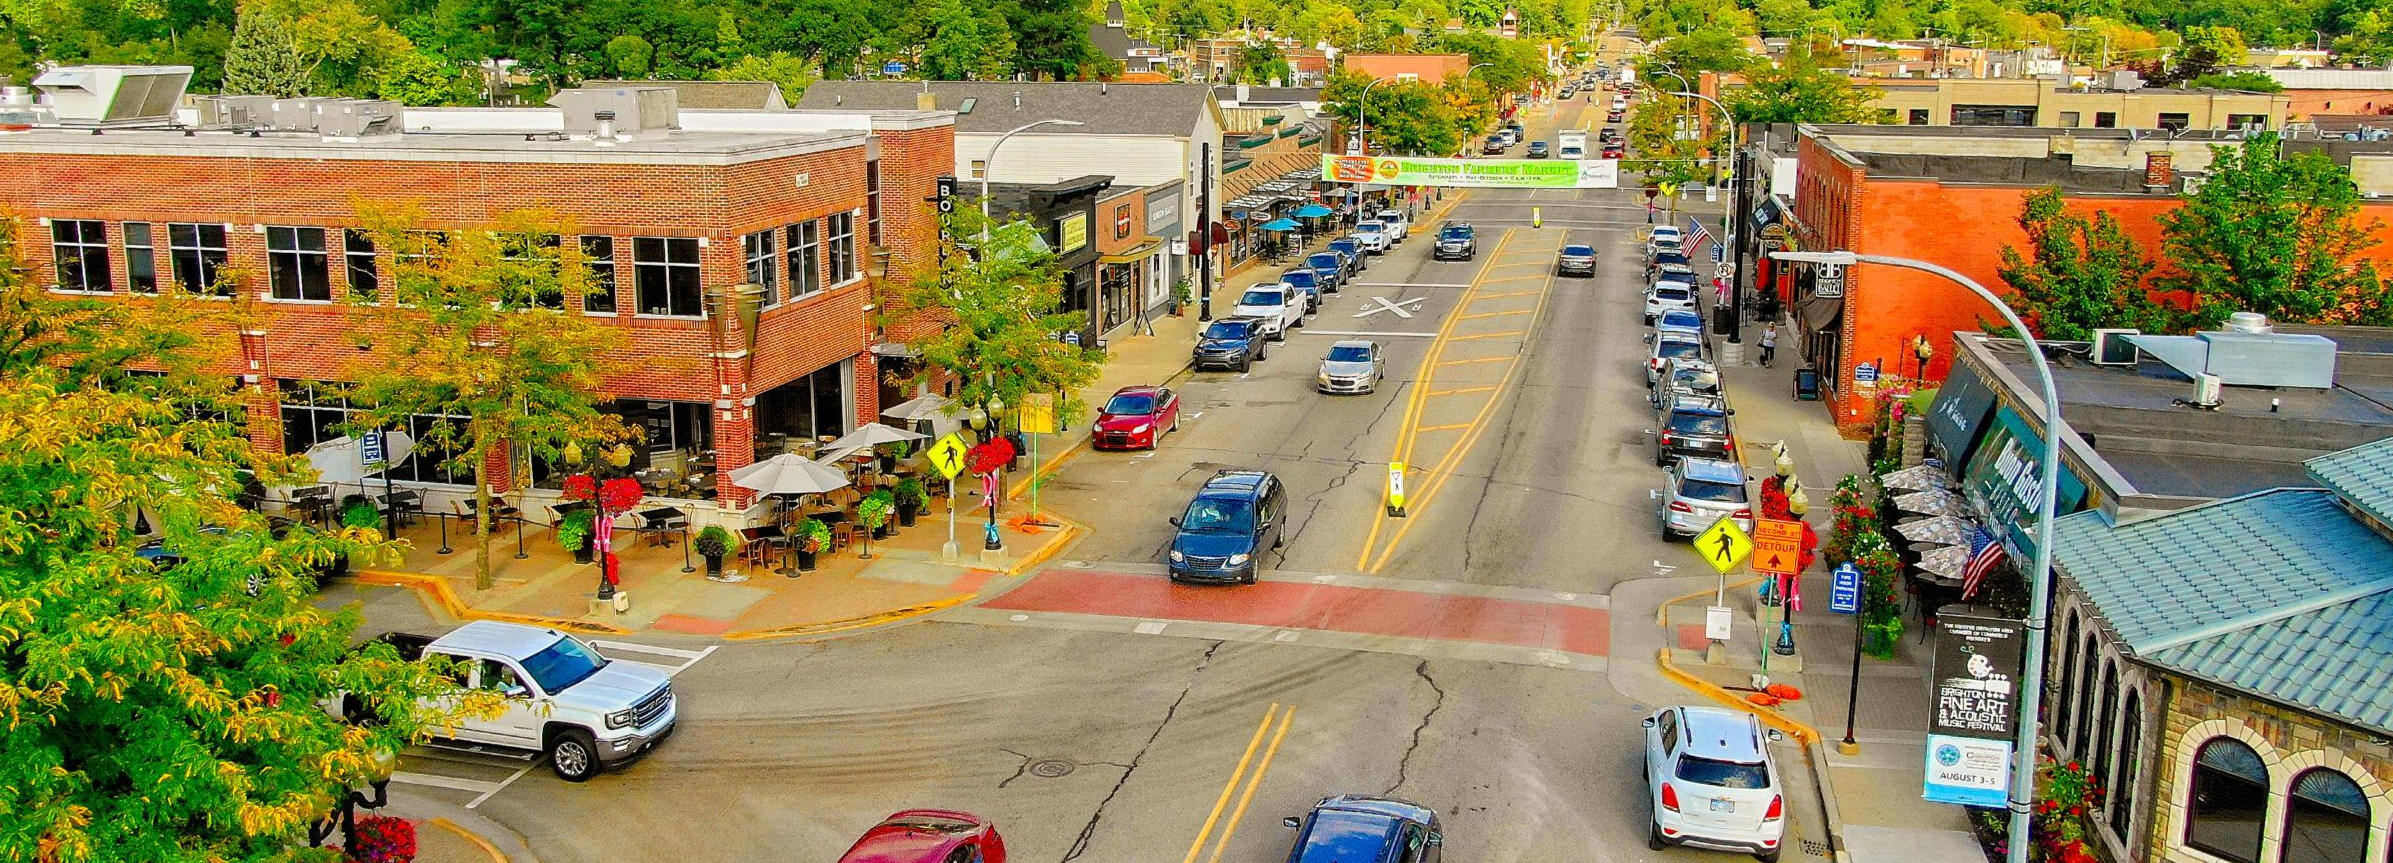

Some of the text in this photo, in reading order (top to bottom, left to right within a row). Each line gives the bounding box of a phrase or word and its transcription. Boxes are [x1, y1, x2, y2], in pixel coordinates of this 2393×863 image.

[1463, 163, 1519, 175] FARMERS
[1522, 164, 1572, 175] MARKET
[1994, 436, 2023, 486] Buon
[1757, 527, 1787, 536] SECOND
[1756, 541, 1796, 553] DETOUR
[1941, 688, 1985, 699] BRIGHTON
[1940, 696, 2008, 715] FINE ART
[1939, 709, 2007, 724] & ACOUSTIC
[1938, 718, 2006, 732] MUSIC FESTIVAL
[1940, 772, 1995, 785] AUGUST 3-5
